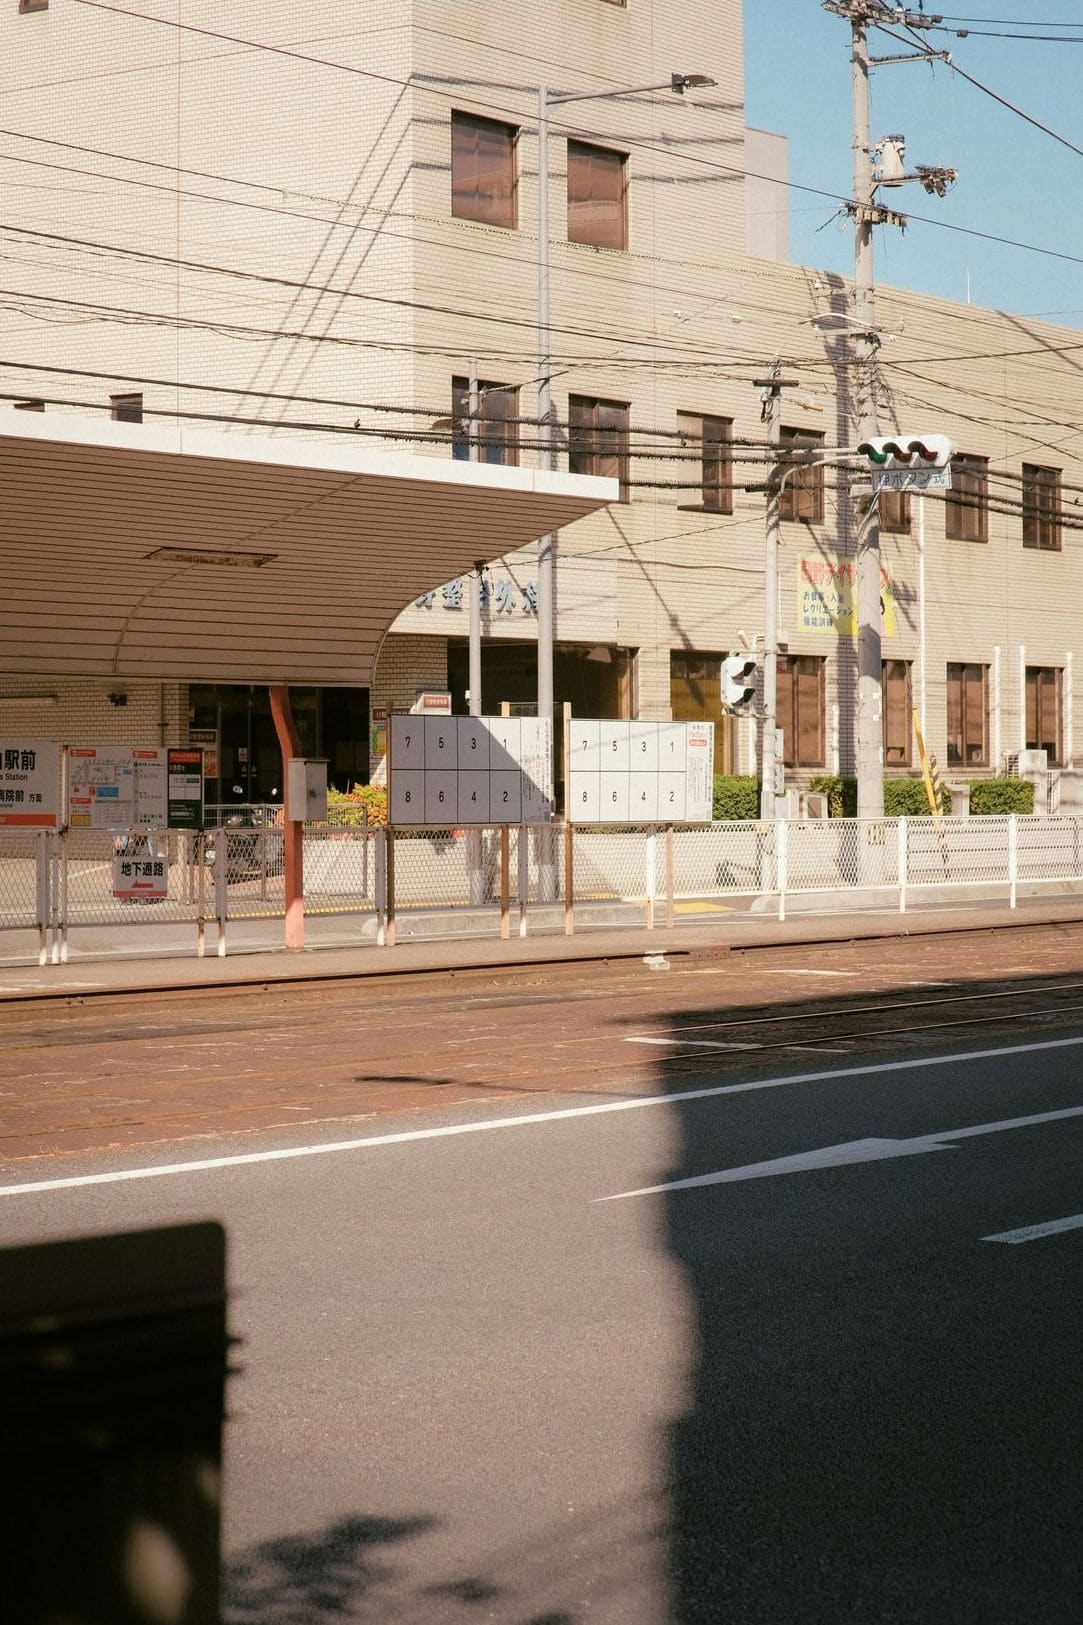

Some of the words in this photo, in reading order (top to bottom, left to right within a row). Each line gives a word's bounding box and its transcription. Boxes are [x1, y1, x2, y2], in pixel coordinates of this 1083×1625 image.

[878, 469, 946, 488] 押ボタン式
[803, 603, 854, 616] レクリエーション
[405, 736, 411, 748] 7
[438, 737, 445, 749] 5
[471, 737, 477, 750] 3
[582, 740, 588, 751] 7
[612, 740, 618, 752] 5
[641, 741, 647, 752] 3
[0, 749, 36, 771] 駅前
[5, 773, 28, 781] Station
[28, 793, 43, 803] 方面
[405, 791, 411, 803] 8
[438, 791, 445, 803] 6
[471, 791, 477, 803] 4
[502, 791, 509, 803] 2
[582, 791, 588, 803] 8
[612, 791, 618, 803] 6
[641, 791, 647, 803] 4
[669, 791, 675, 803] 2
[121, 861, 164, 877] 地下通路
